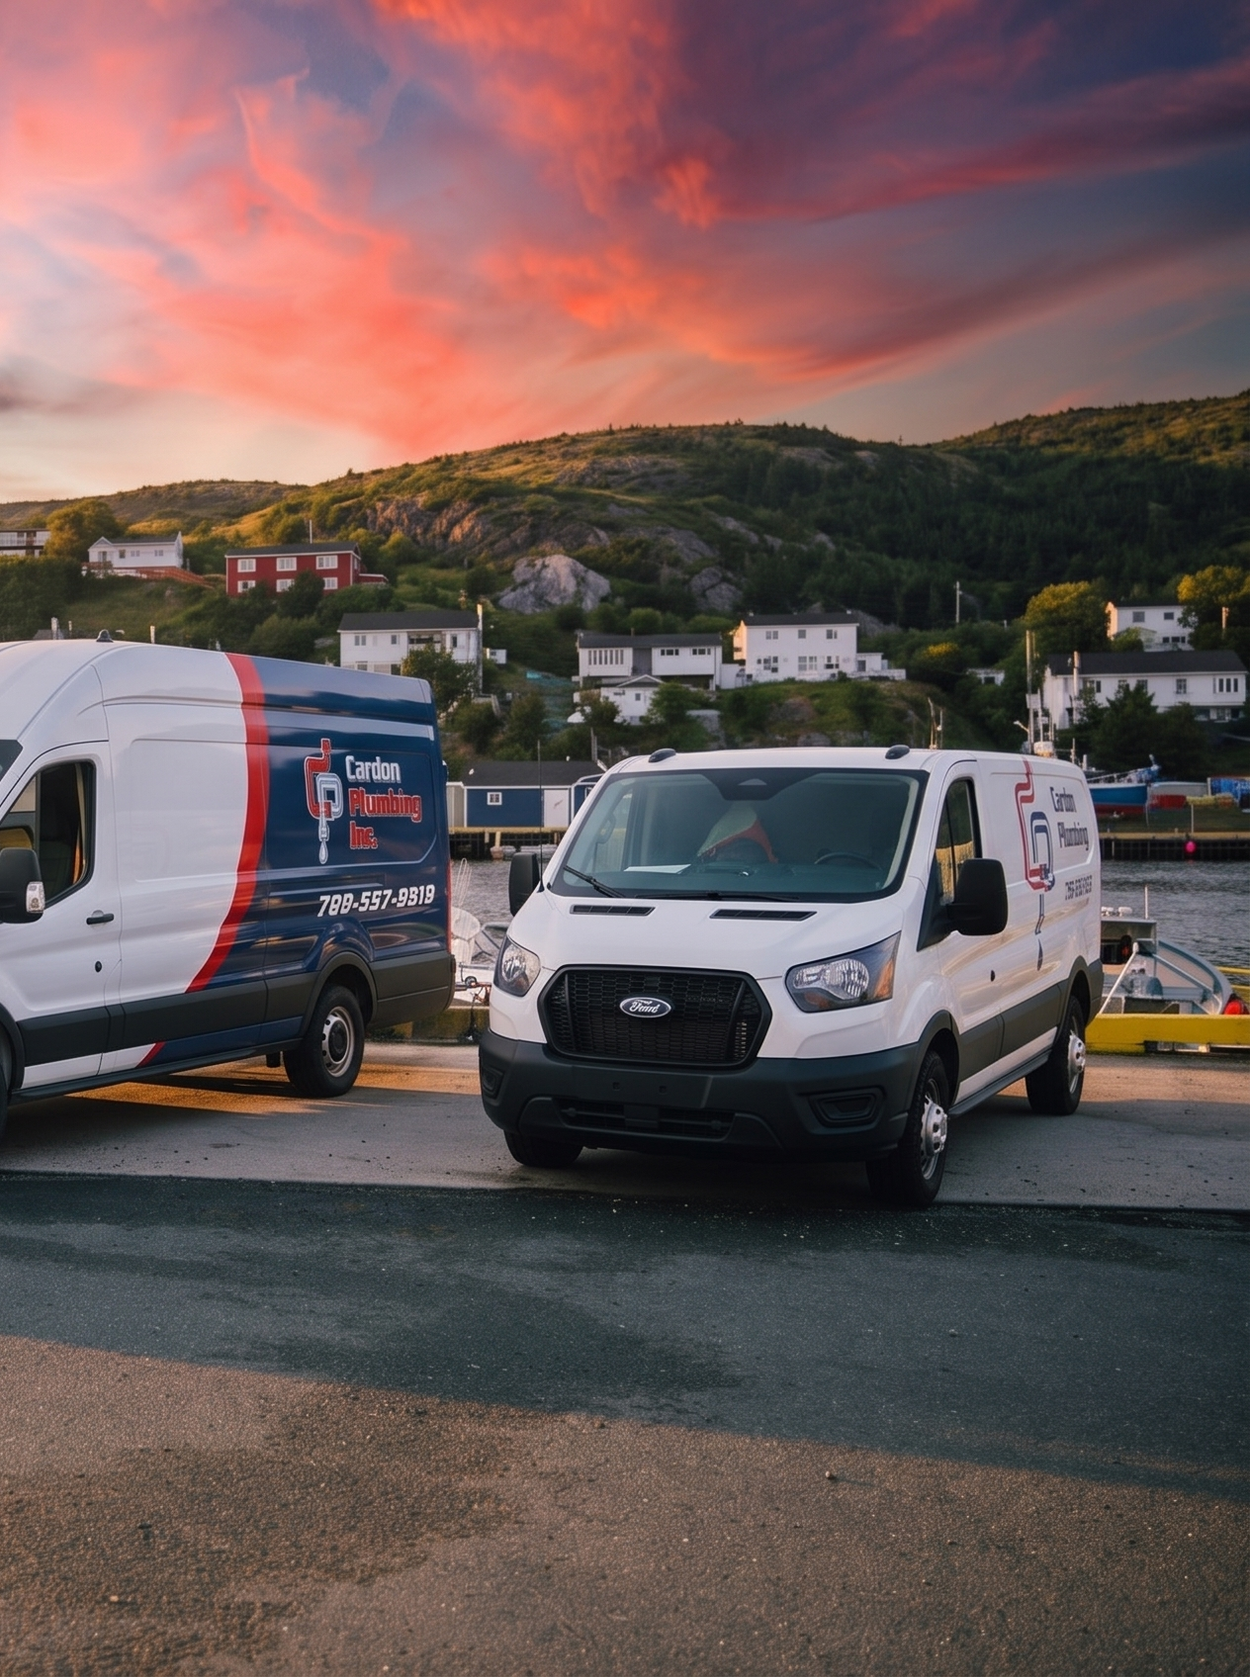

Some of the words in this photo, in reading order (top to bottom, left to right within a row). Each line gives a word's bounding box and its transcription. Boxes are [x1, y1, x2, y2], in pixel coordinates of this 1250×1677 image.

[345, 755, 401, 783] Cardon
[348, 787, 422, 823] Plumbing
[629, 1000, 661, 1013] Ford
